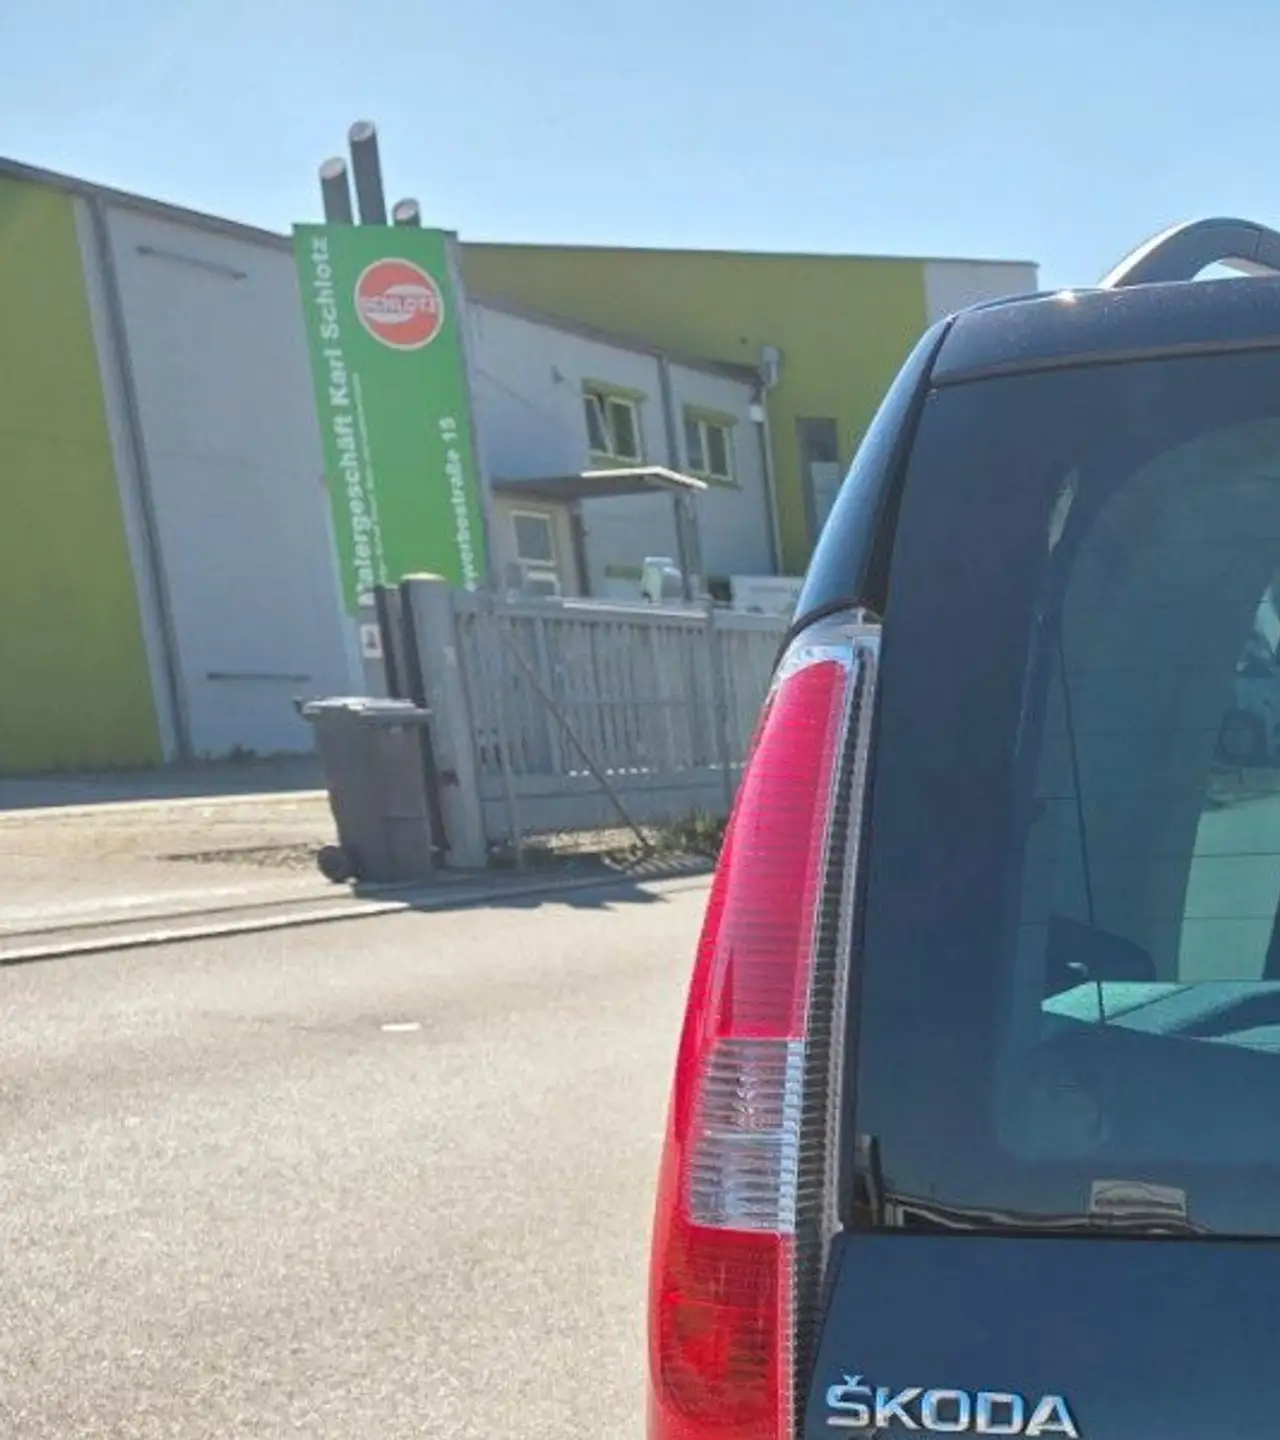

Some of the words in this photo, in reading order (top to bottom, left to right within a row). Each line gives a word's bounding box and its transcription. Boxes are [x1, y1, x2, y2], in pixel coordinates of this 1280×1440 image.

[311, 235, 341, 339] Schlotz
[324, 349, 349, 404] Karl
[444, 451, 477, 592] ewerbestraße
[825, 1373, 1080, 1439] ŠKODA
